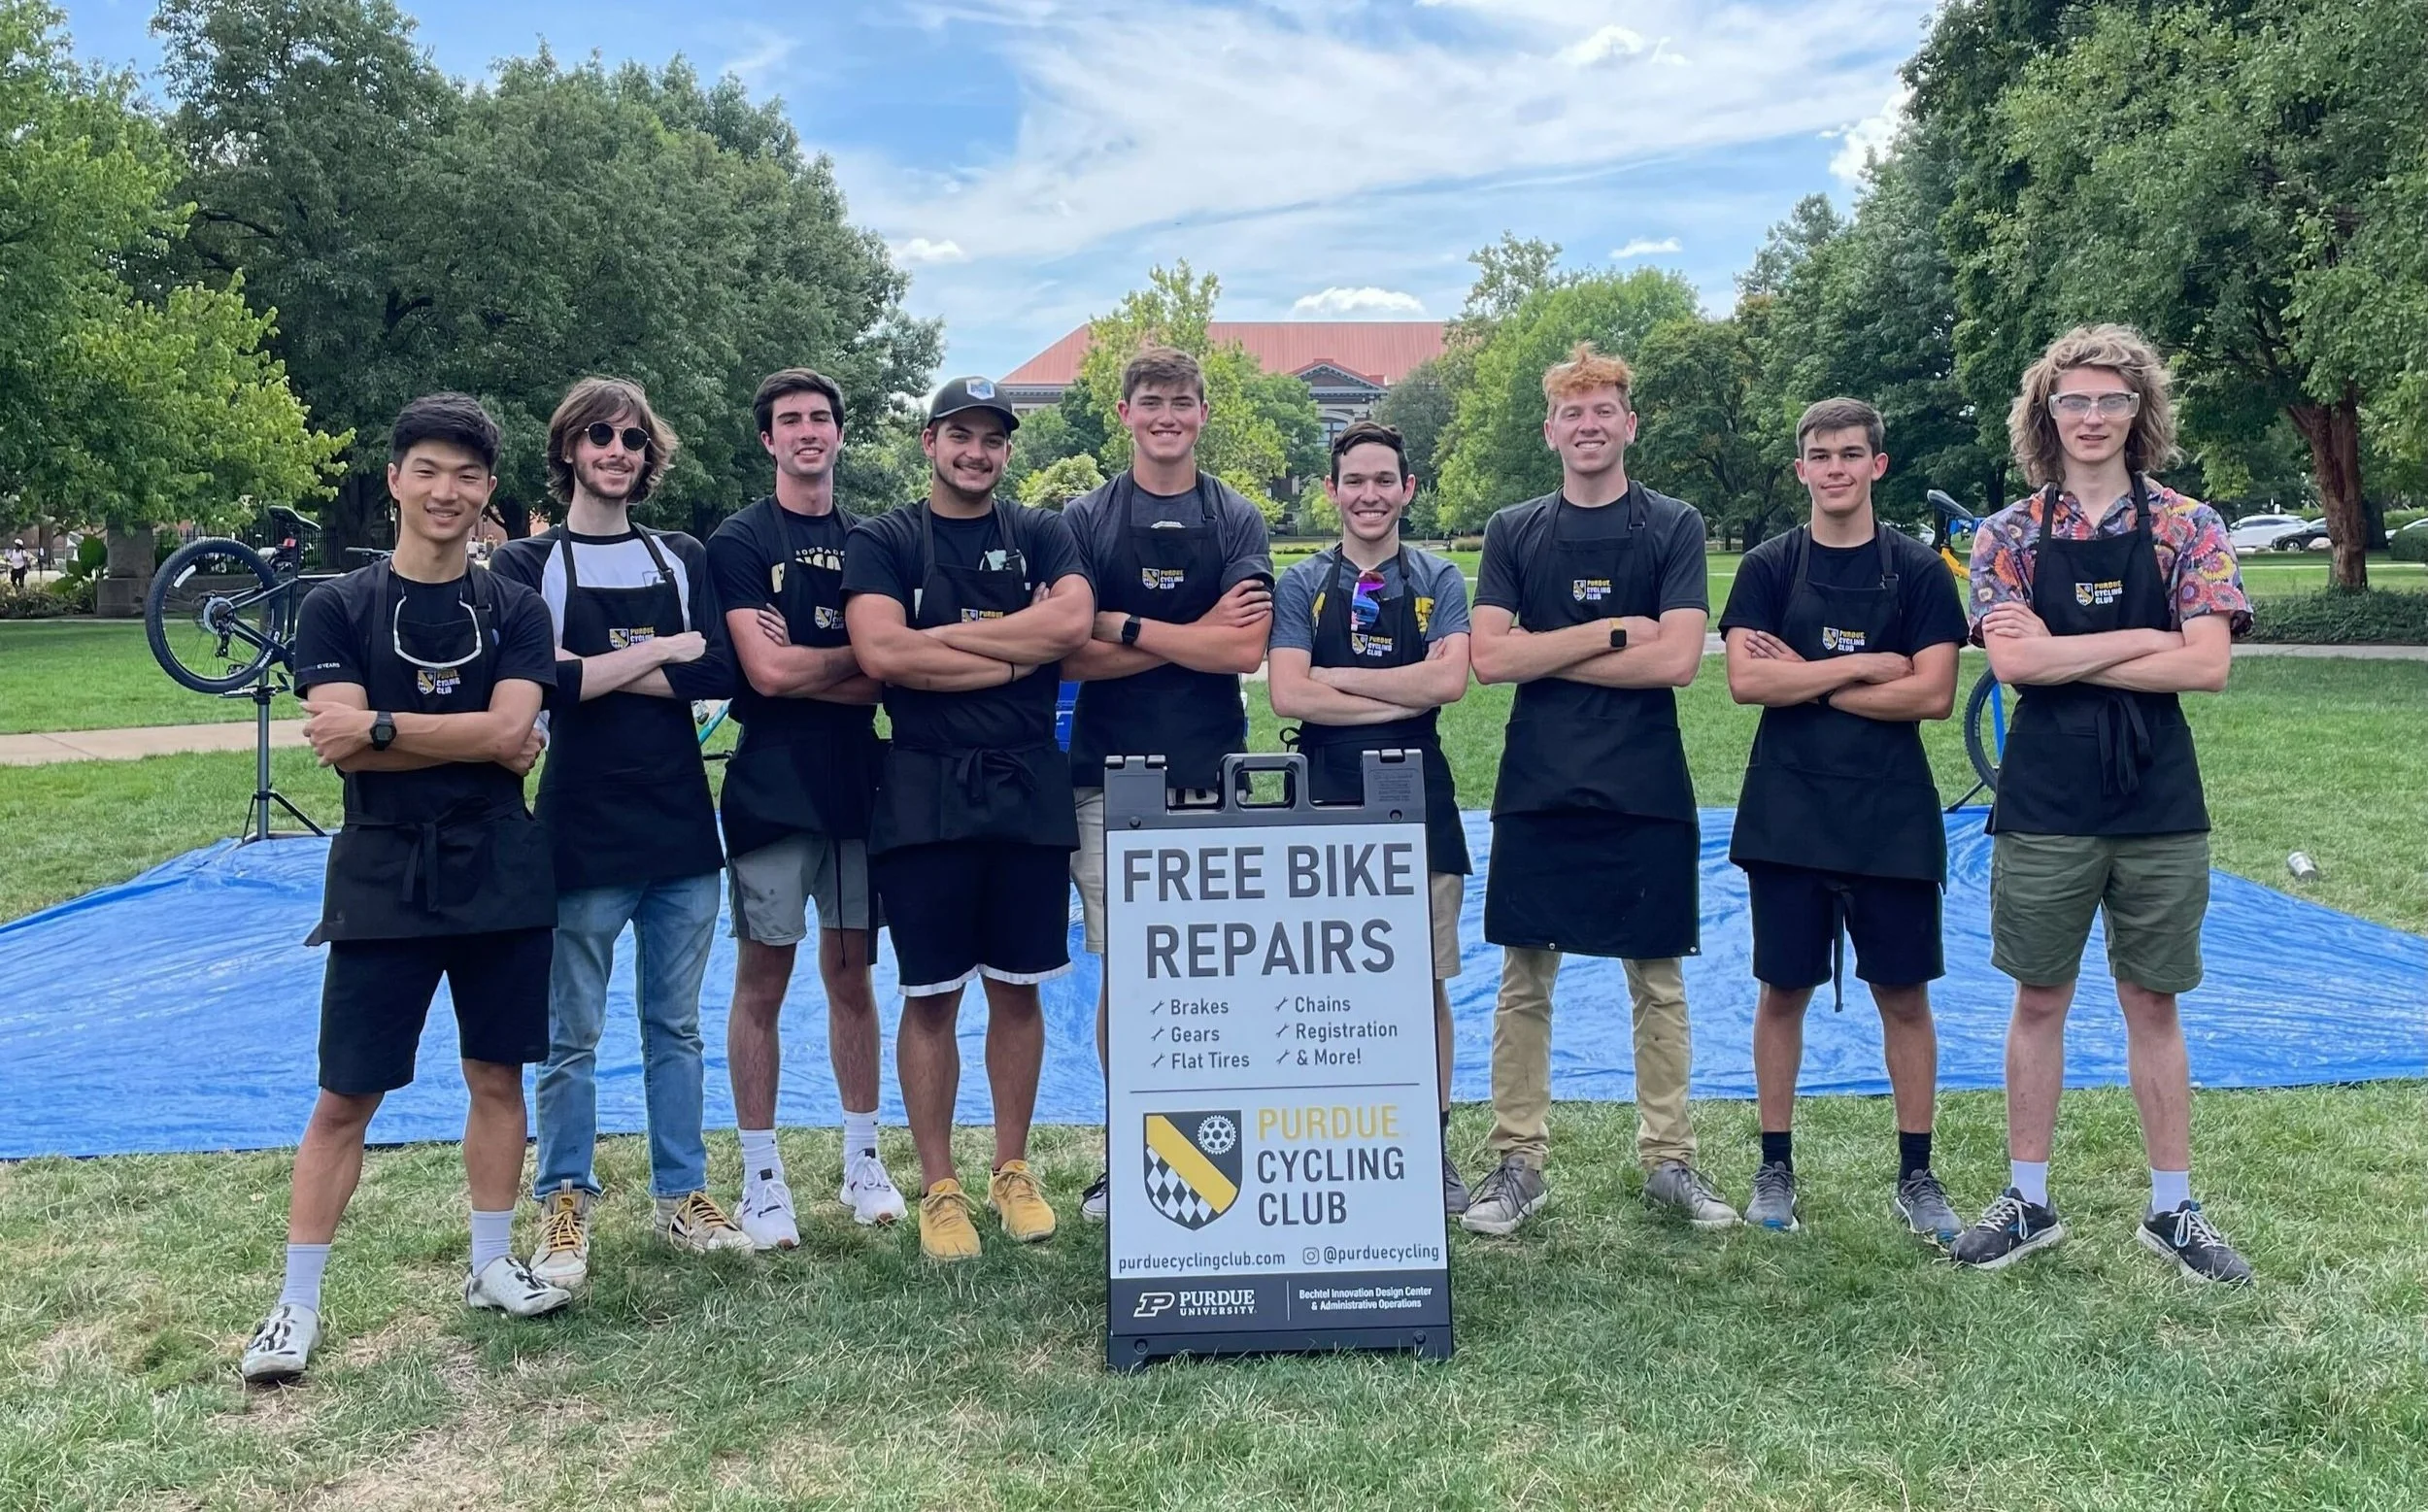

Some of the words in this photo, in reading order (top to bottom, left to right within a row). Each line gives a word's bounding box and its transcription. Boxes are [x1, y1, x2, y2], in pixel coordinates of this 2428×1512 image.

[1124, 847, 1265, 902] FREE
[1287, 843, 1414, 898] BIKE
[1146, 919, 1396, 979] REPAIRS
[1171, 997, 1229, 1015] Brakes
[1295, 995, 1351, 1013] Chains
[1171, 1026, 1220, 1042] Gears
[1296, 1021, 1398, 1043] Registration
[1172, 1052, 1203, 1069] Flat
[1208, 1052, 1250, 1068] Tires
[1297, 1049, 1308, 1065] &
[1314, 1048, 1362, 1065] More!
[1258, 1105, 1399, 1141] PURDUE
[1257, 1146, 1404, 1184] CYCLING
[1259, 1191, 1347, 1226] CLUB
[1119, 1251, 1286, 1273] purduecyclingclub.com
[1324, 1243, 1439, 1263] @purduecycling
[1179, 1290, 1256, 1307] PURDUE
[1298, 1289, 1331, 1299] Bechtel
[1332, 1288, 1374, 1298] Innovation
[1375, 1287, 1403, 1298] Design
[1405, 1286, 1433, 1296] Center
[1179, 1306, 1256, 1317] UNIVERSITY
[1311, 1301, 1318, 1311] &
[1320, 1299, 1377, 1311] Administrative
[1378, 1297, 1422, 1310] Operations
